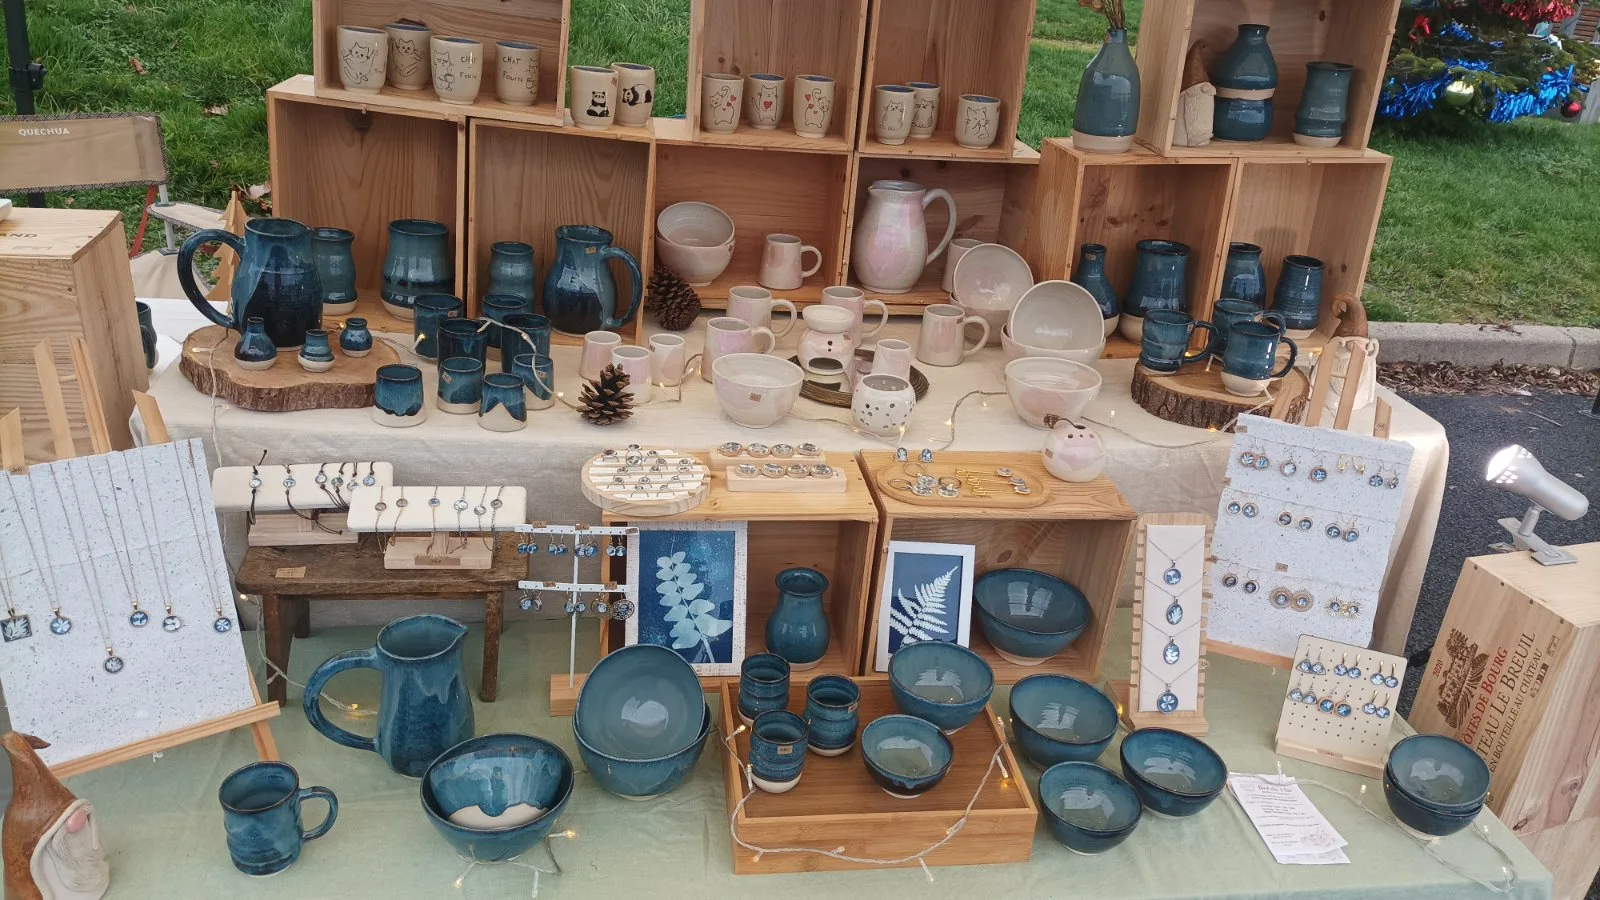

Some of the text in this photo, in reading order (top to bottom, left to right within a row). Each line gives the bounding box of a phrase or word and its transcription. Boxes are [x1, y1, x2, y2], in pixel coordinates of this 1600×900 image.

[502, 56, 521, 64] CHAT
[18, 128, 70, 136] QUECHUA
[1432, 658, 1444, 678] 2020
[1500, 632, 1536, 692] BREUIL
[1462, 646, 1508, 744] ÔTES DE BOURG
[1488, 758, 1497, 773] EN
[1496, 708, 1518, 760] BOUTEILLE
[1516, 694, 1524, 710] AU
[1520, 648, 1542, 694] CHÂTEAU
